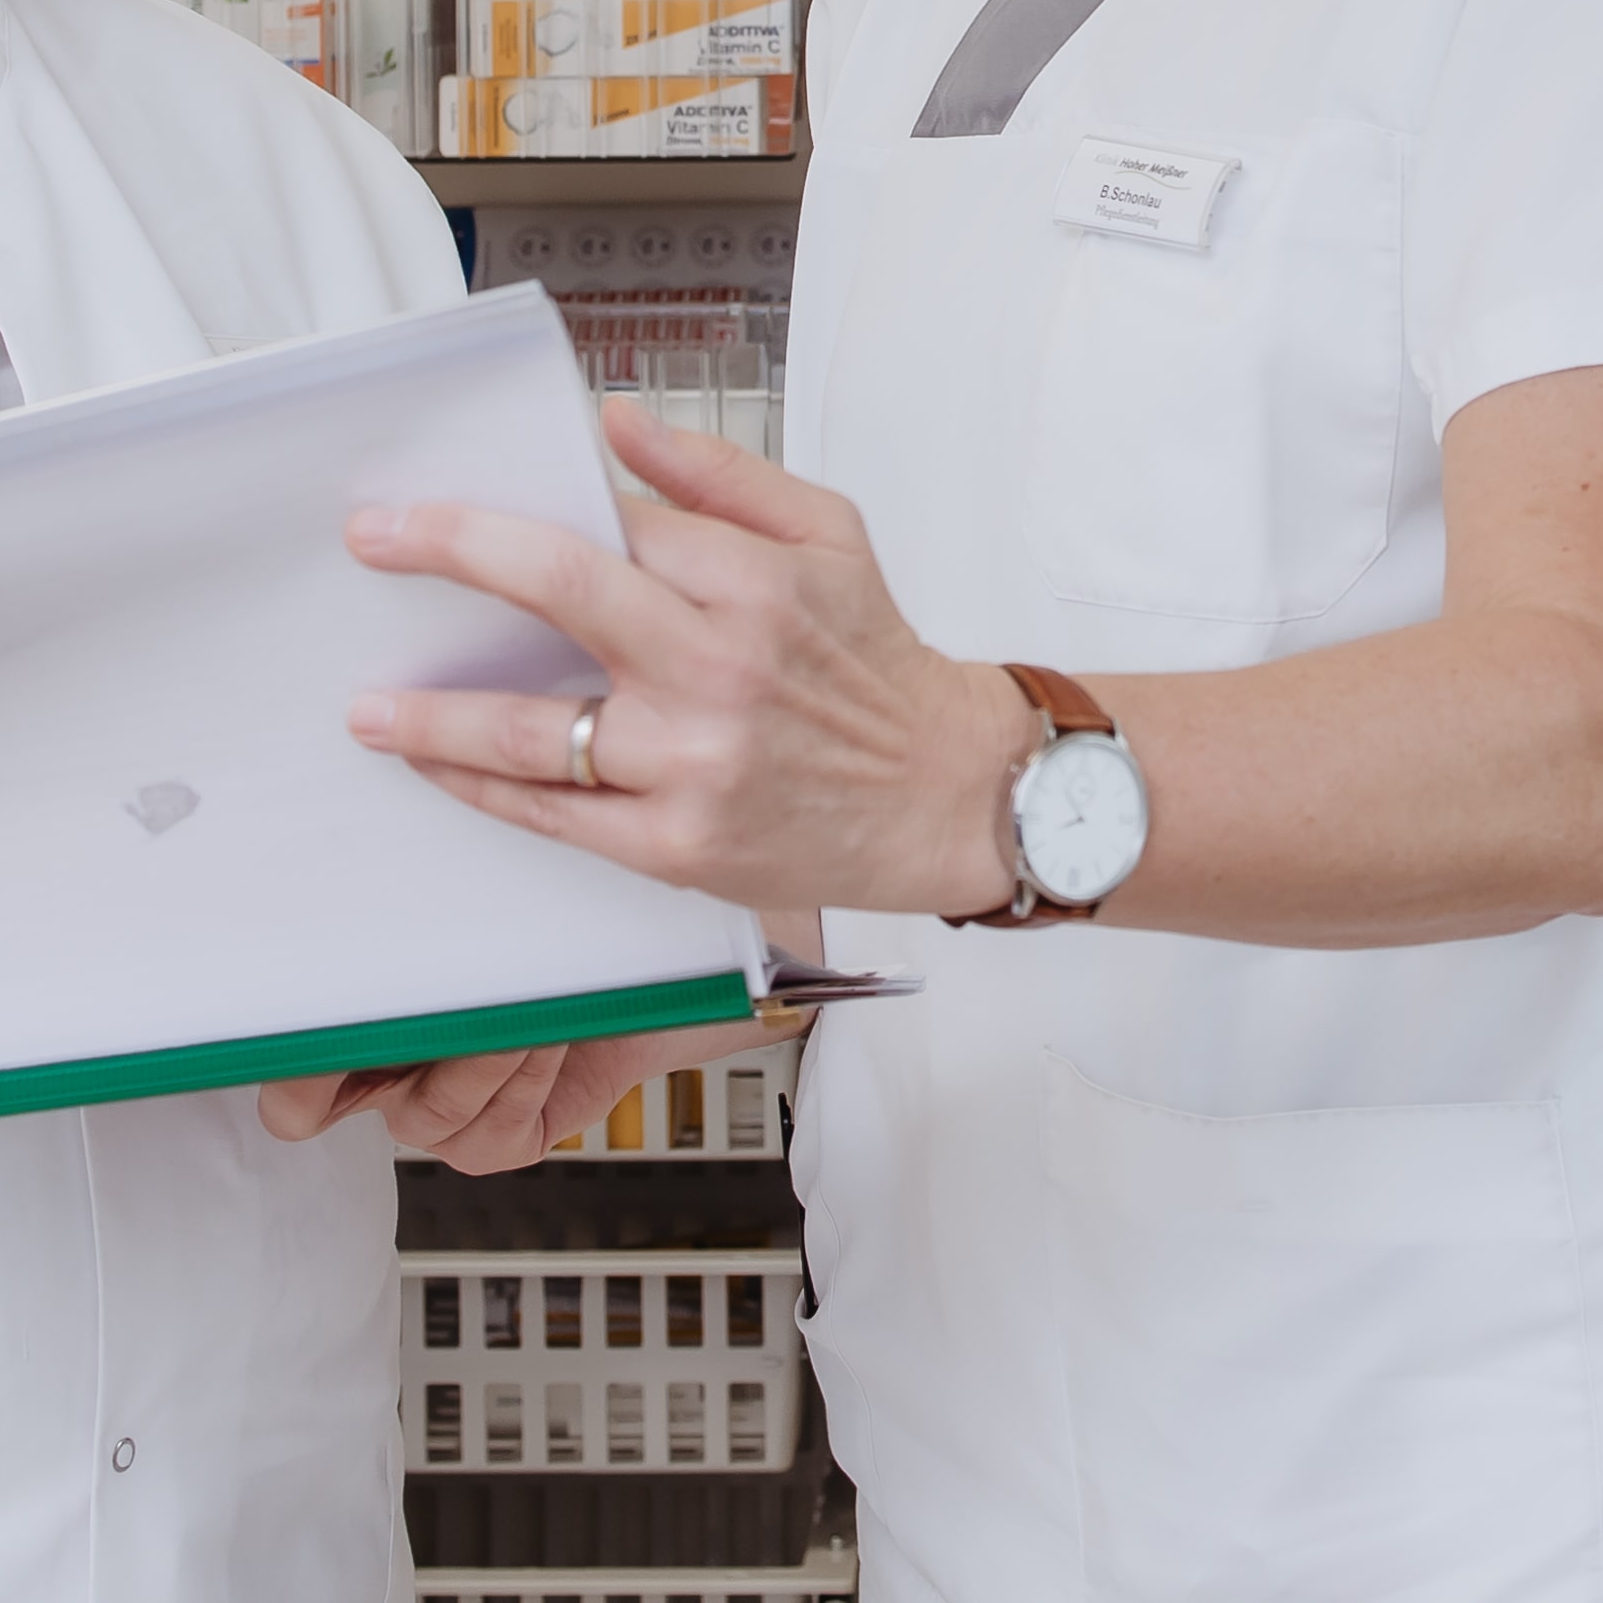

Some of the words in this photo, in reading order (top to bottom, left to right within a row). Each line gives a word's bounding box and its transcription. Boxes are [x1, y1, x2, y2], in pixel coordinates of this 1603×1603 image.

[768, 39, 781, 55] C
[736, 119, 749, 135] C
[1119, 157, 1149, 172] Hoher
